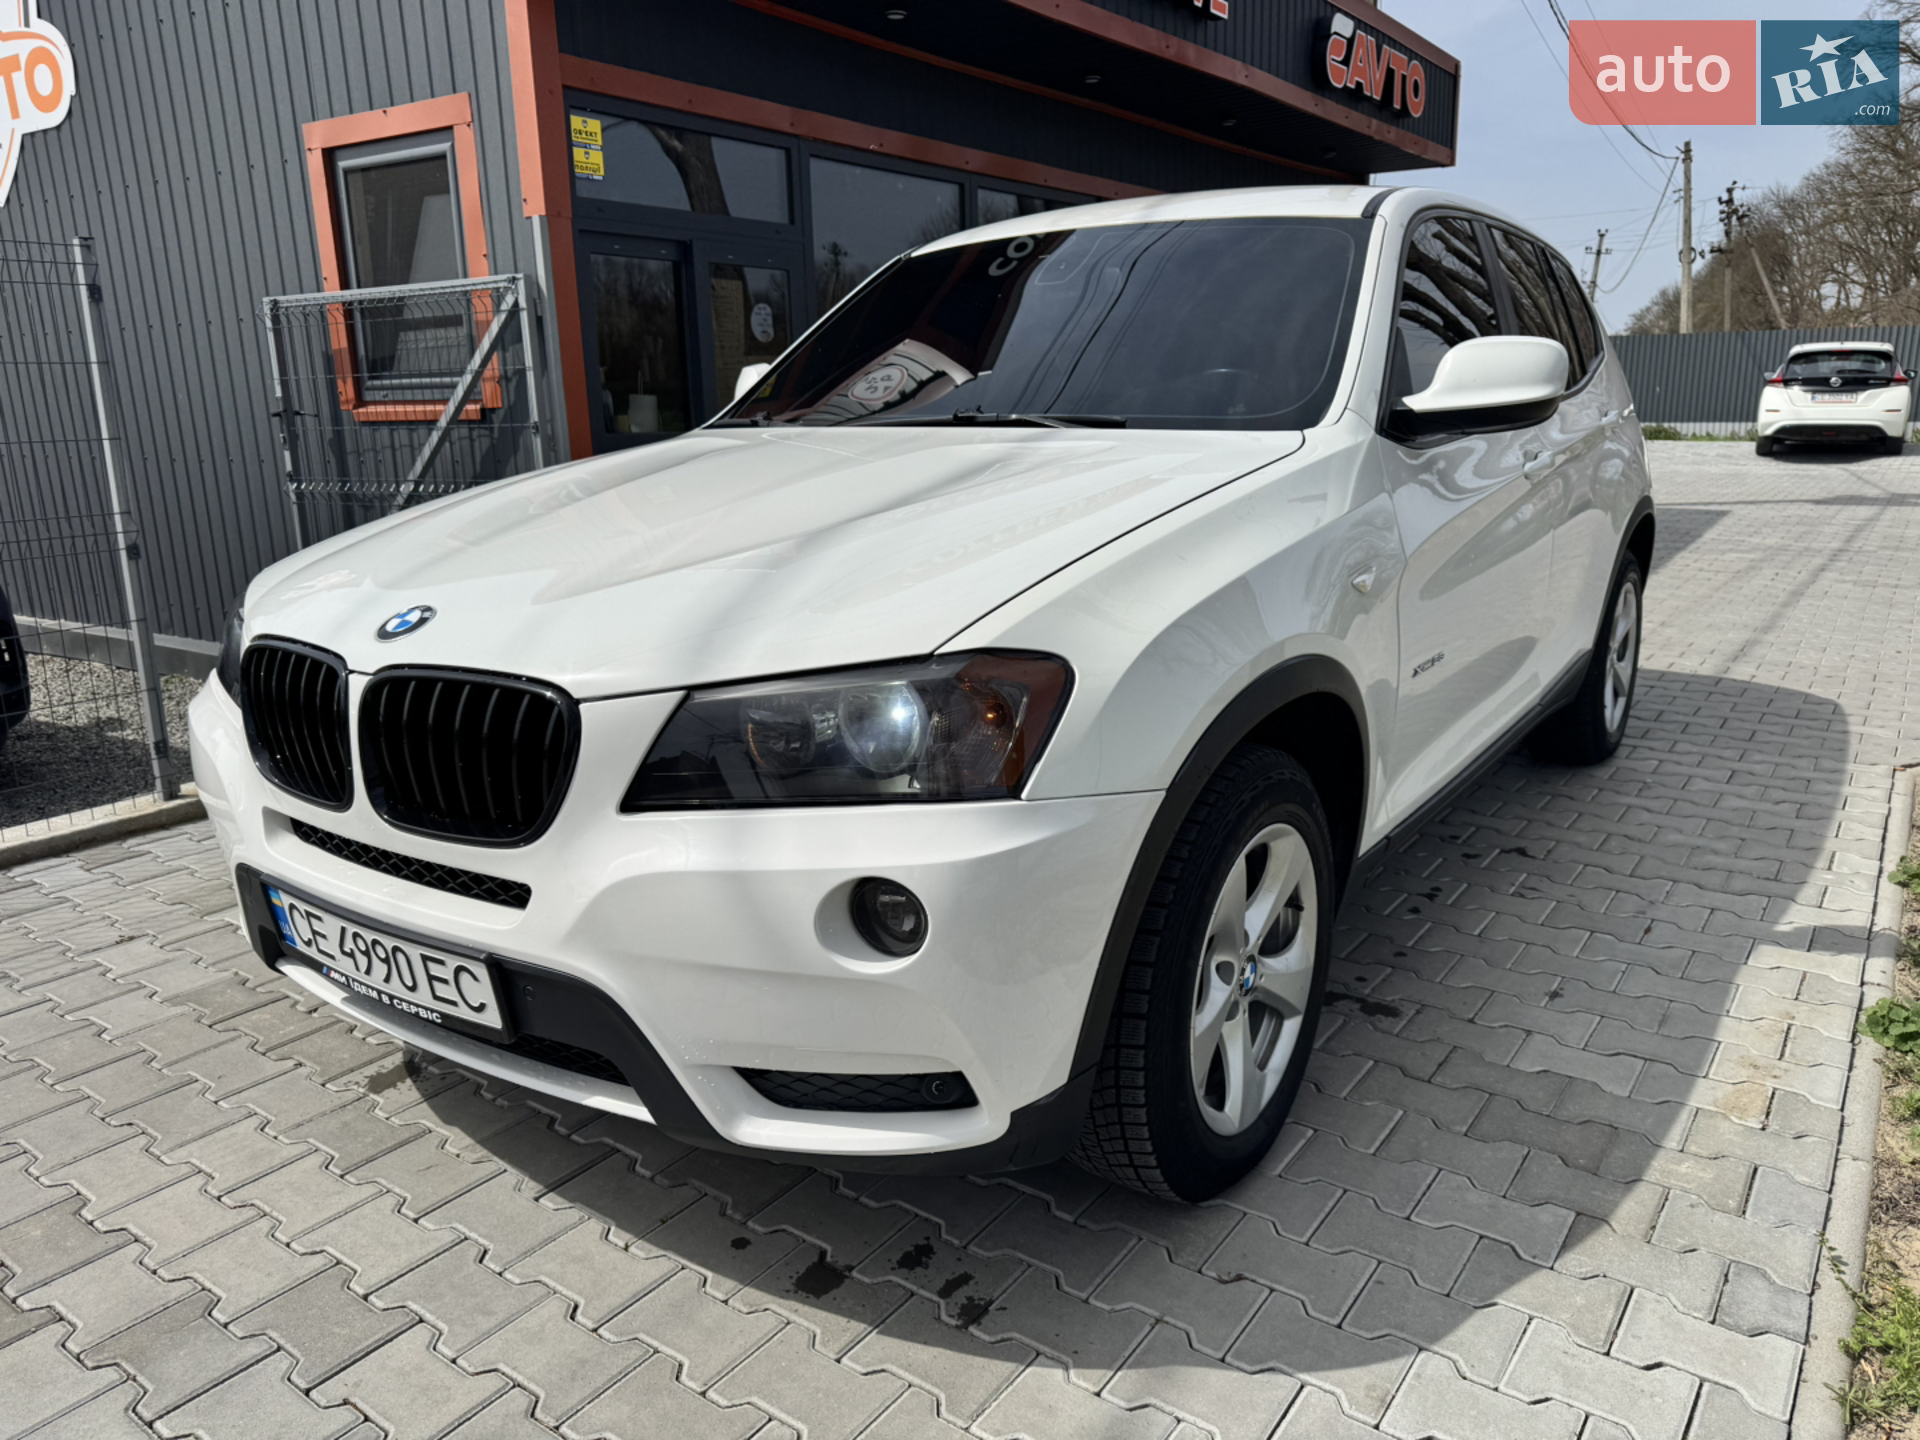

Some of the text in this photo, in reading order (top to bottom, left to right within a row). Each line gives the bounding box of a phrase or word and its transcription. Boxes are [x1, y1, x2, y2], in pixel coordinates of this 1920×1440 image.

[288, 902, 487, 1014] CE 4990 EC
[393, 999, 443, 1024] СЕРВІС
